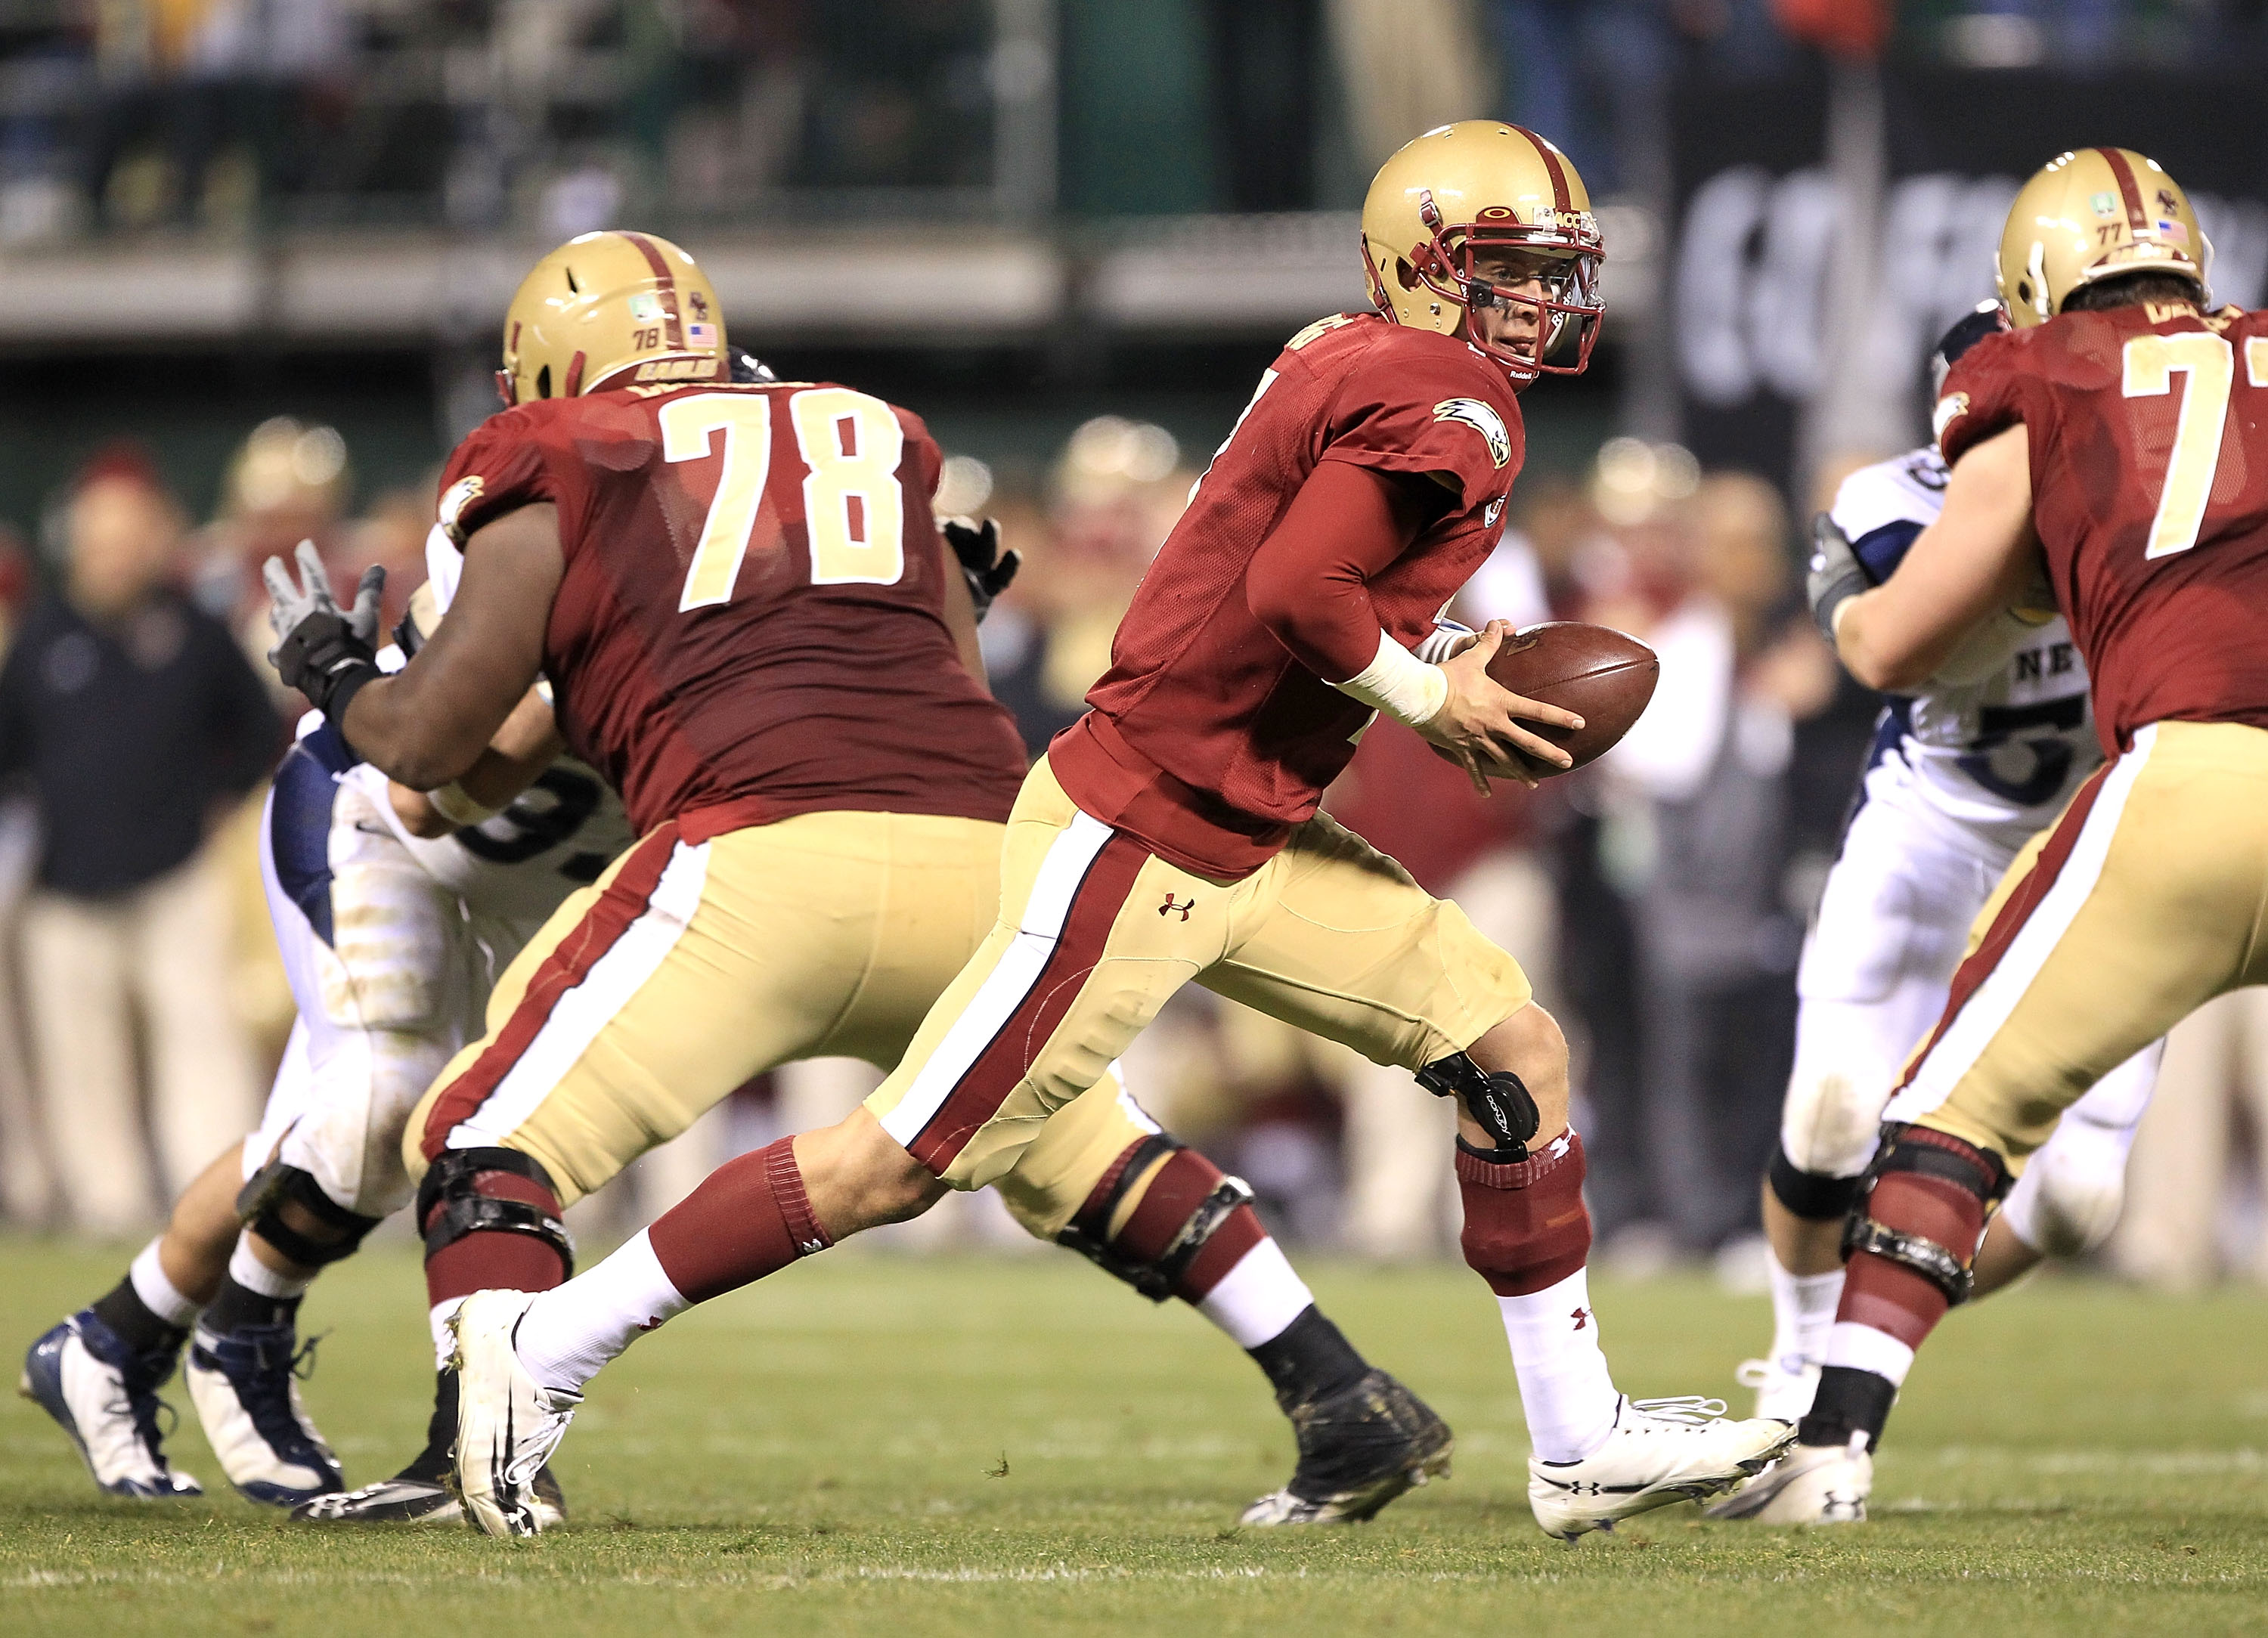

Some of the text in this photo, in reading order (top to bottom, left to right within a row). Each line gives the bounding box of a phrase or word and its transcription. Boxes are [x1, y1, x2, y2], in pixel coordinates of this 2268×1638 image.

[1554, 212, 1580, 229] ACC
[2096, 222, 2123, 245] 77
[633, 327, 659, 351] 78
[1510, 370, 1532, 379] Riddell
[2123, 331, 2268, 559] 7
[658, 389, 904, 612] 78
[1486, 1095, 1511, 1137] DONJOY
